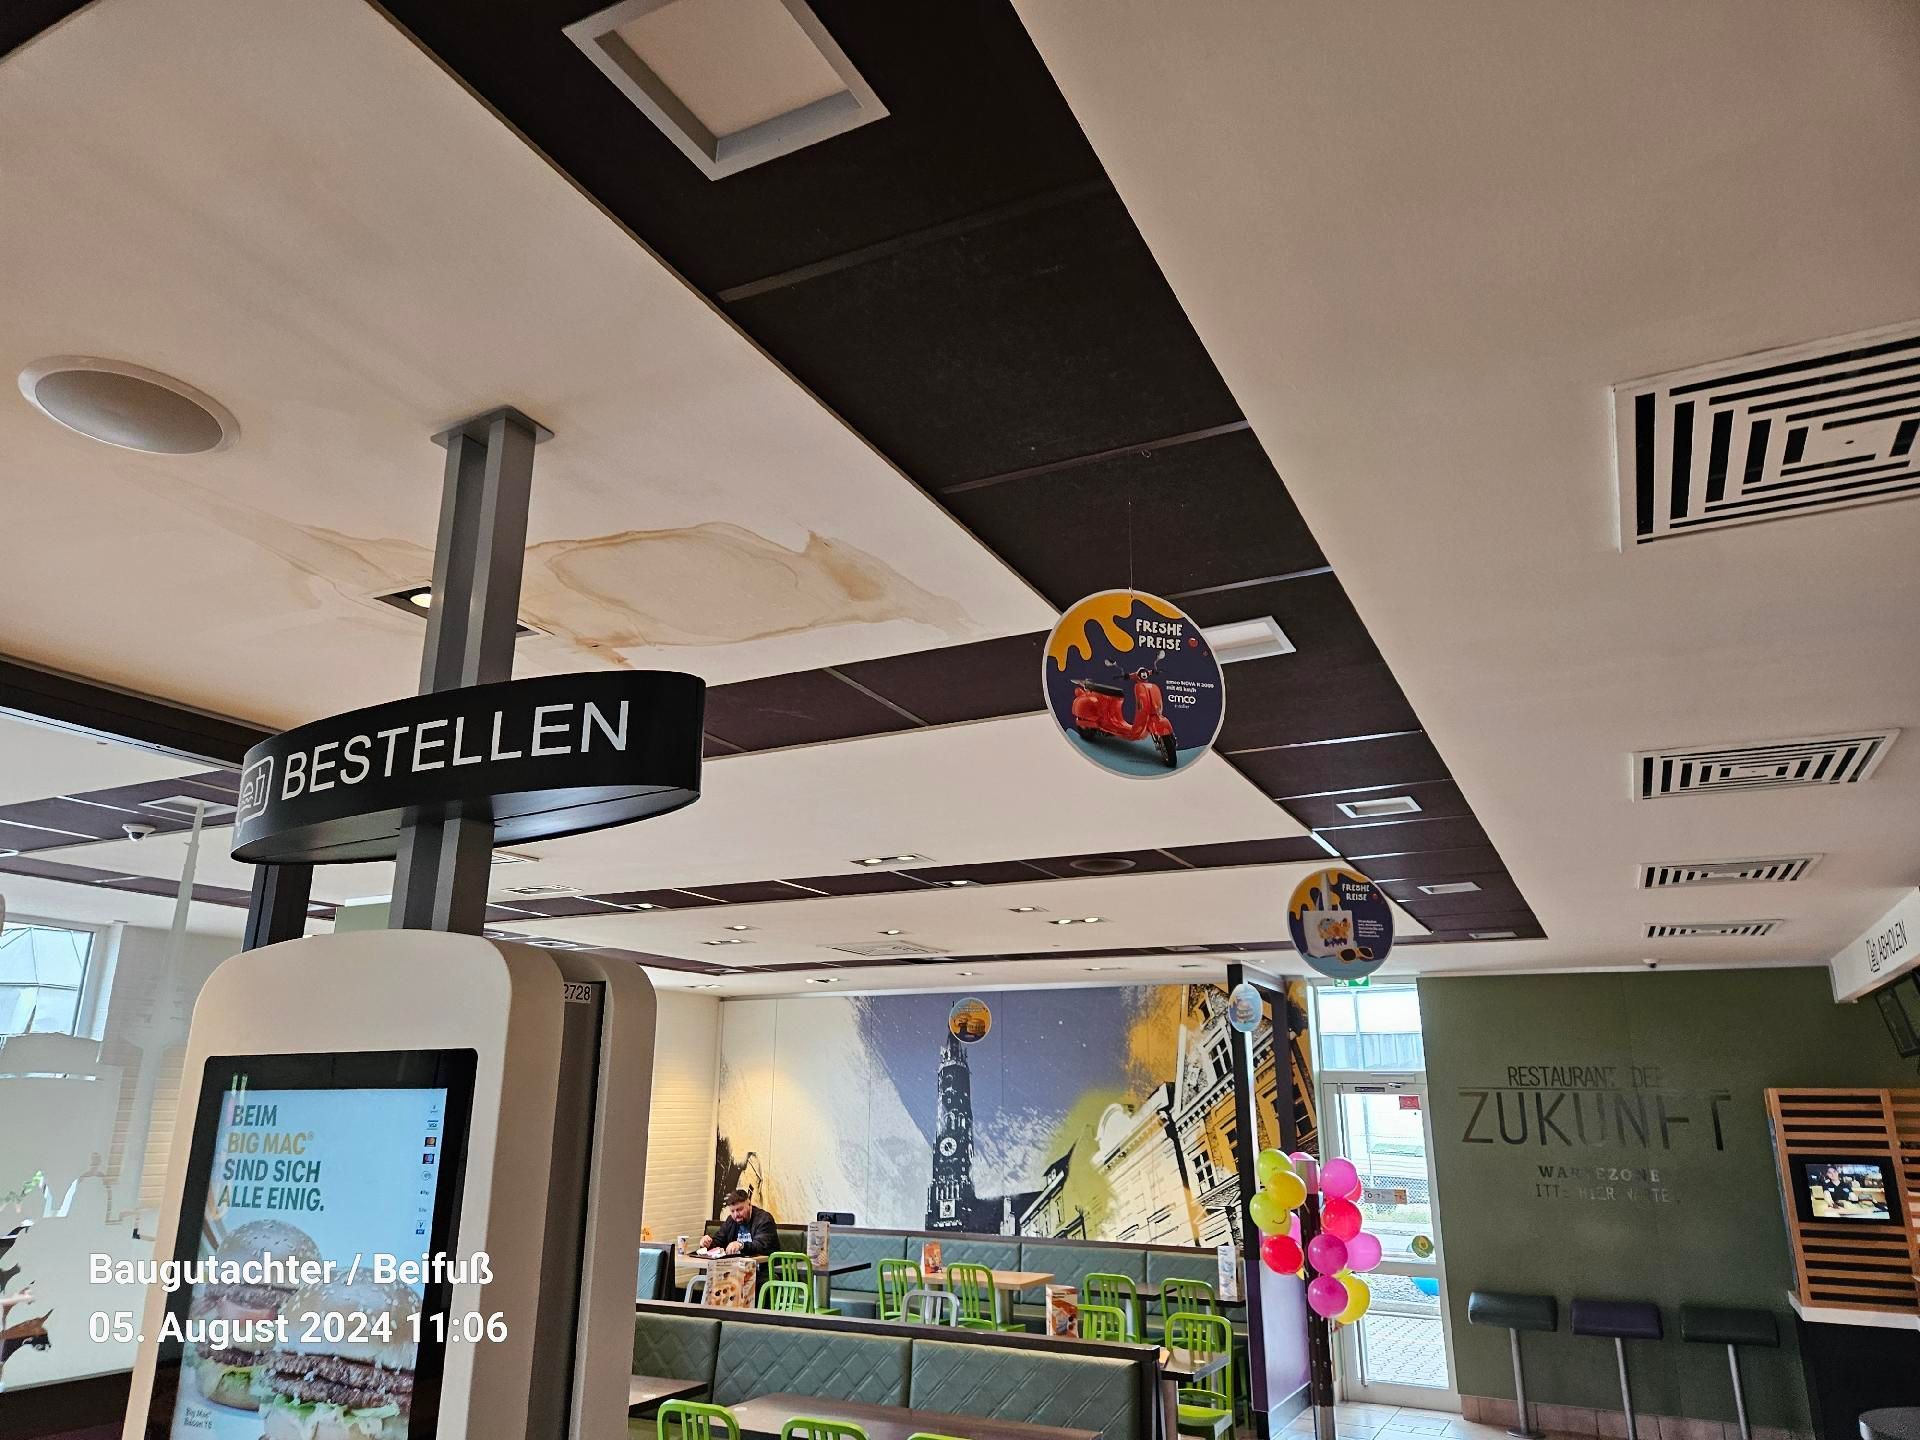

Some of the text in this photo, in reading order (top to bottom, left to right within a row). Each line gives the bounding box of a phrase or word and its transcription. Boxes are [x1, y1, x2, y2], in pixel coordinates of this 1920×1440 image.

[1136, 619, 1182, 636] FRESHE
[1138, 635, 1181, 650] PREISE
[1168, 695, 1196, 704] emco
[282, 700, 629, 800] BESTELLEN
[1342, 883, 1370, 892] FRESHE
[1878, 920, 1907, 962] ABHOLEN
[232, 1105, 277, 1127] BEIM
[227, 1132, 259, 1153] BIG
[223, 1159, 321, 1183] SIND SICH
[218, 1185, 324, 1211] ALLE EINIG.
